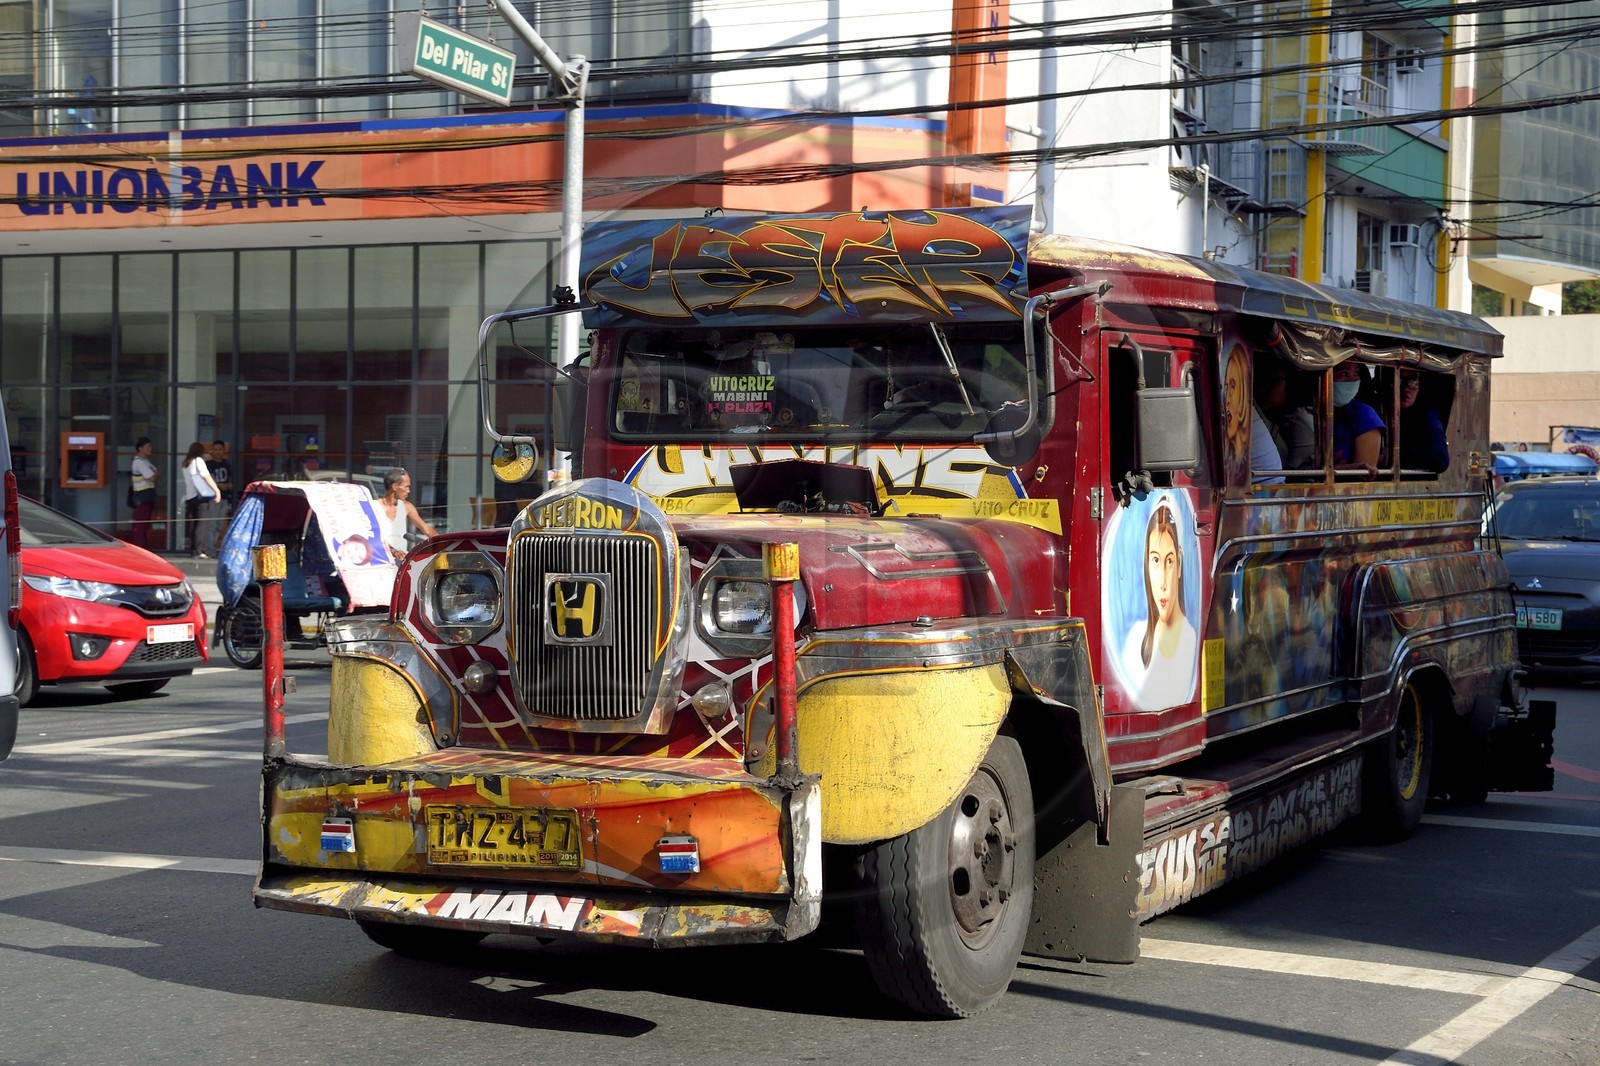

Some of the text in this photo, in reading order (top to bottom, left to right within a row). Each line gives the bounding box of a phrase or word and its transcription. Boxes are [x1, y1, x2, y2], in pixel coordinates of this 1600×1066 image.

[421, 34, 508, 89] Del Pilar St
[17, 160, 326, 216] UNIONBANK
[585, 211, 1021, 318] JESTER
[713, 392, 768, 402] MABINI
[541, 496, 623, 530] HEBRON
[972, 501, 1050, 519] VITO CRUZ
[1535, 611, 1557, 624] 580
[1200, 810, 1254, 848] SAID
[1264, 788, 1298, 829] AM
[1298, 774, 1326, 811] THE
[1330, 758, 1363, 795] WAY
[470, 851, 537, 863] PILIPINAS
[1199, 845, 1228, 888] THE
